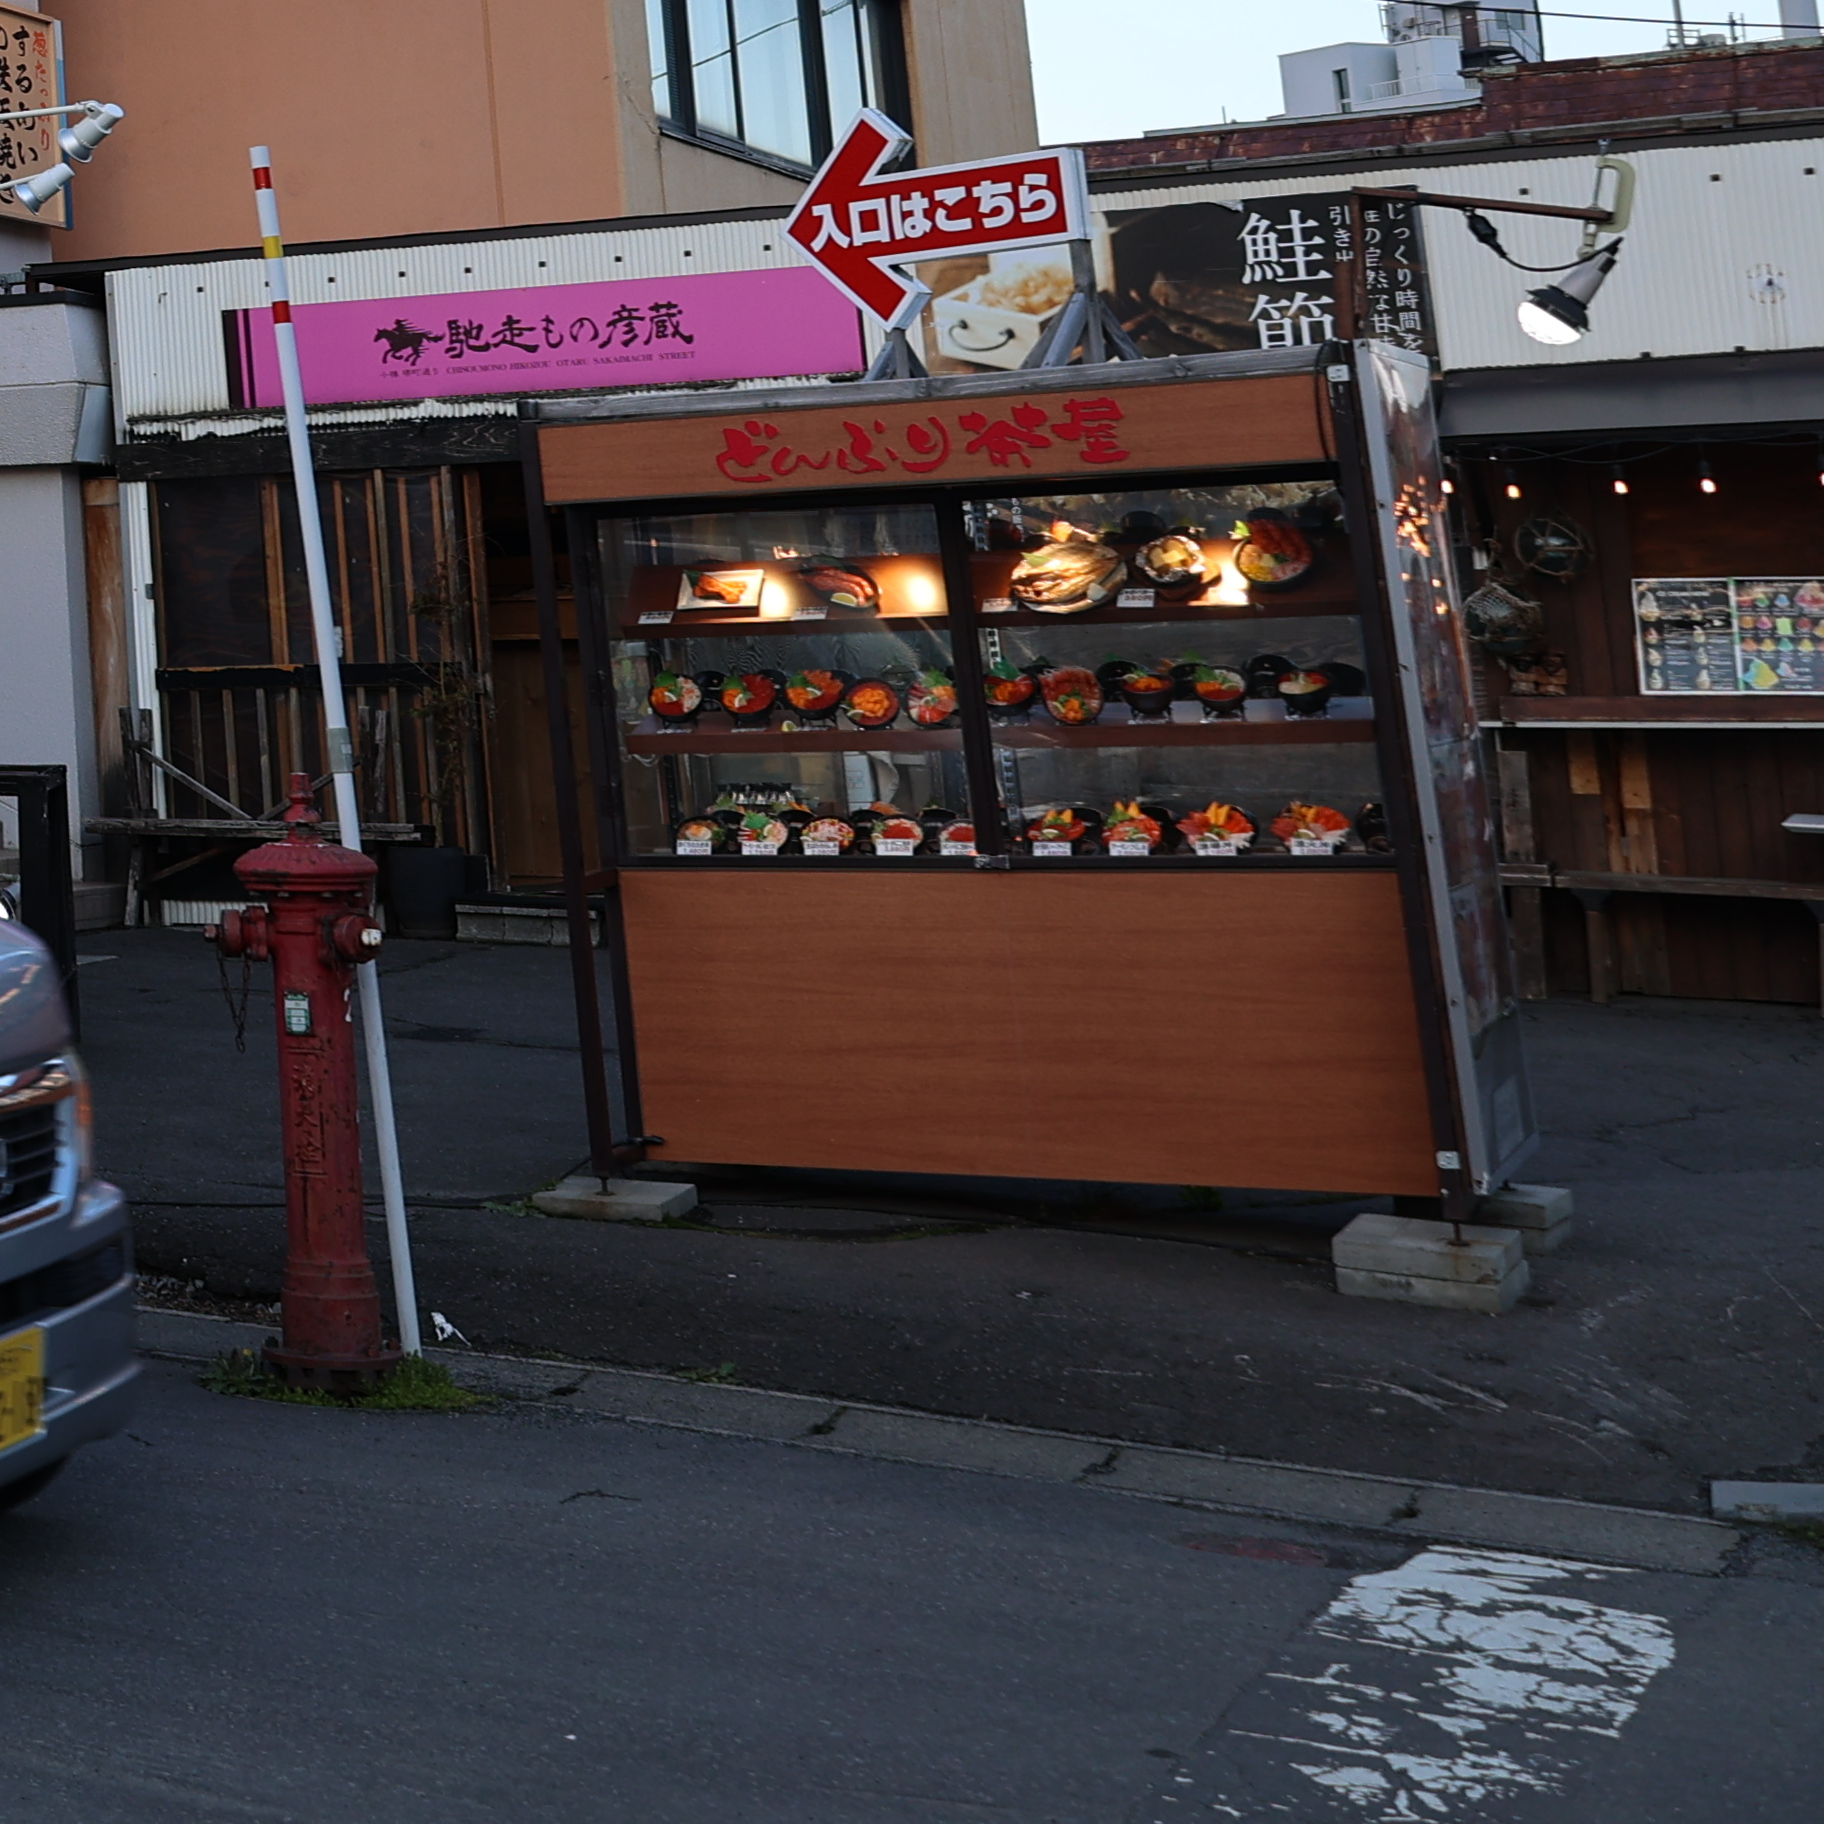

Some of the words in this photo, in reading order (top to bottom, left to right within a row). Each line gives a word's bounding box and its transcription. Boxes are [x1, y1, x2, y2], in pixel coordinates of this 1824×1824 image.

[810, 174, 1057, 253] 入口はこちら
[444, 301, 694, 359] 馳走もの彦蔵
[555, 358, 587, 368] OTARU
[593, 353, 653, 365] SAKAIMACHI
[658, 350, 695, 361] STREET
[716, 397, 1131, 483] どんぶり茶屋
